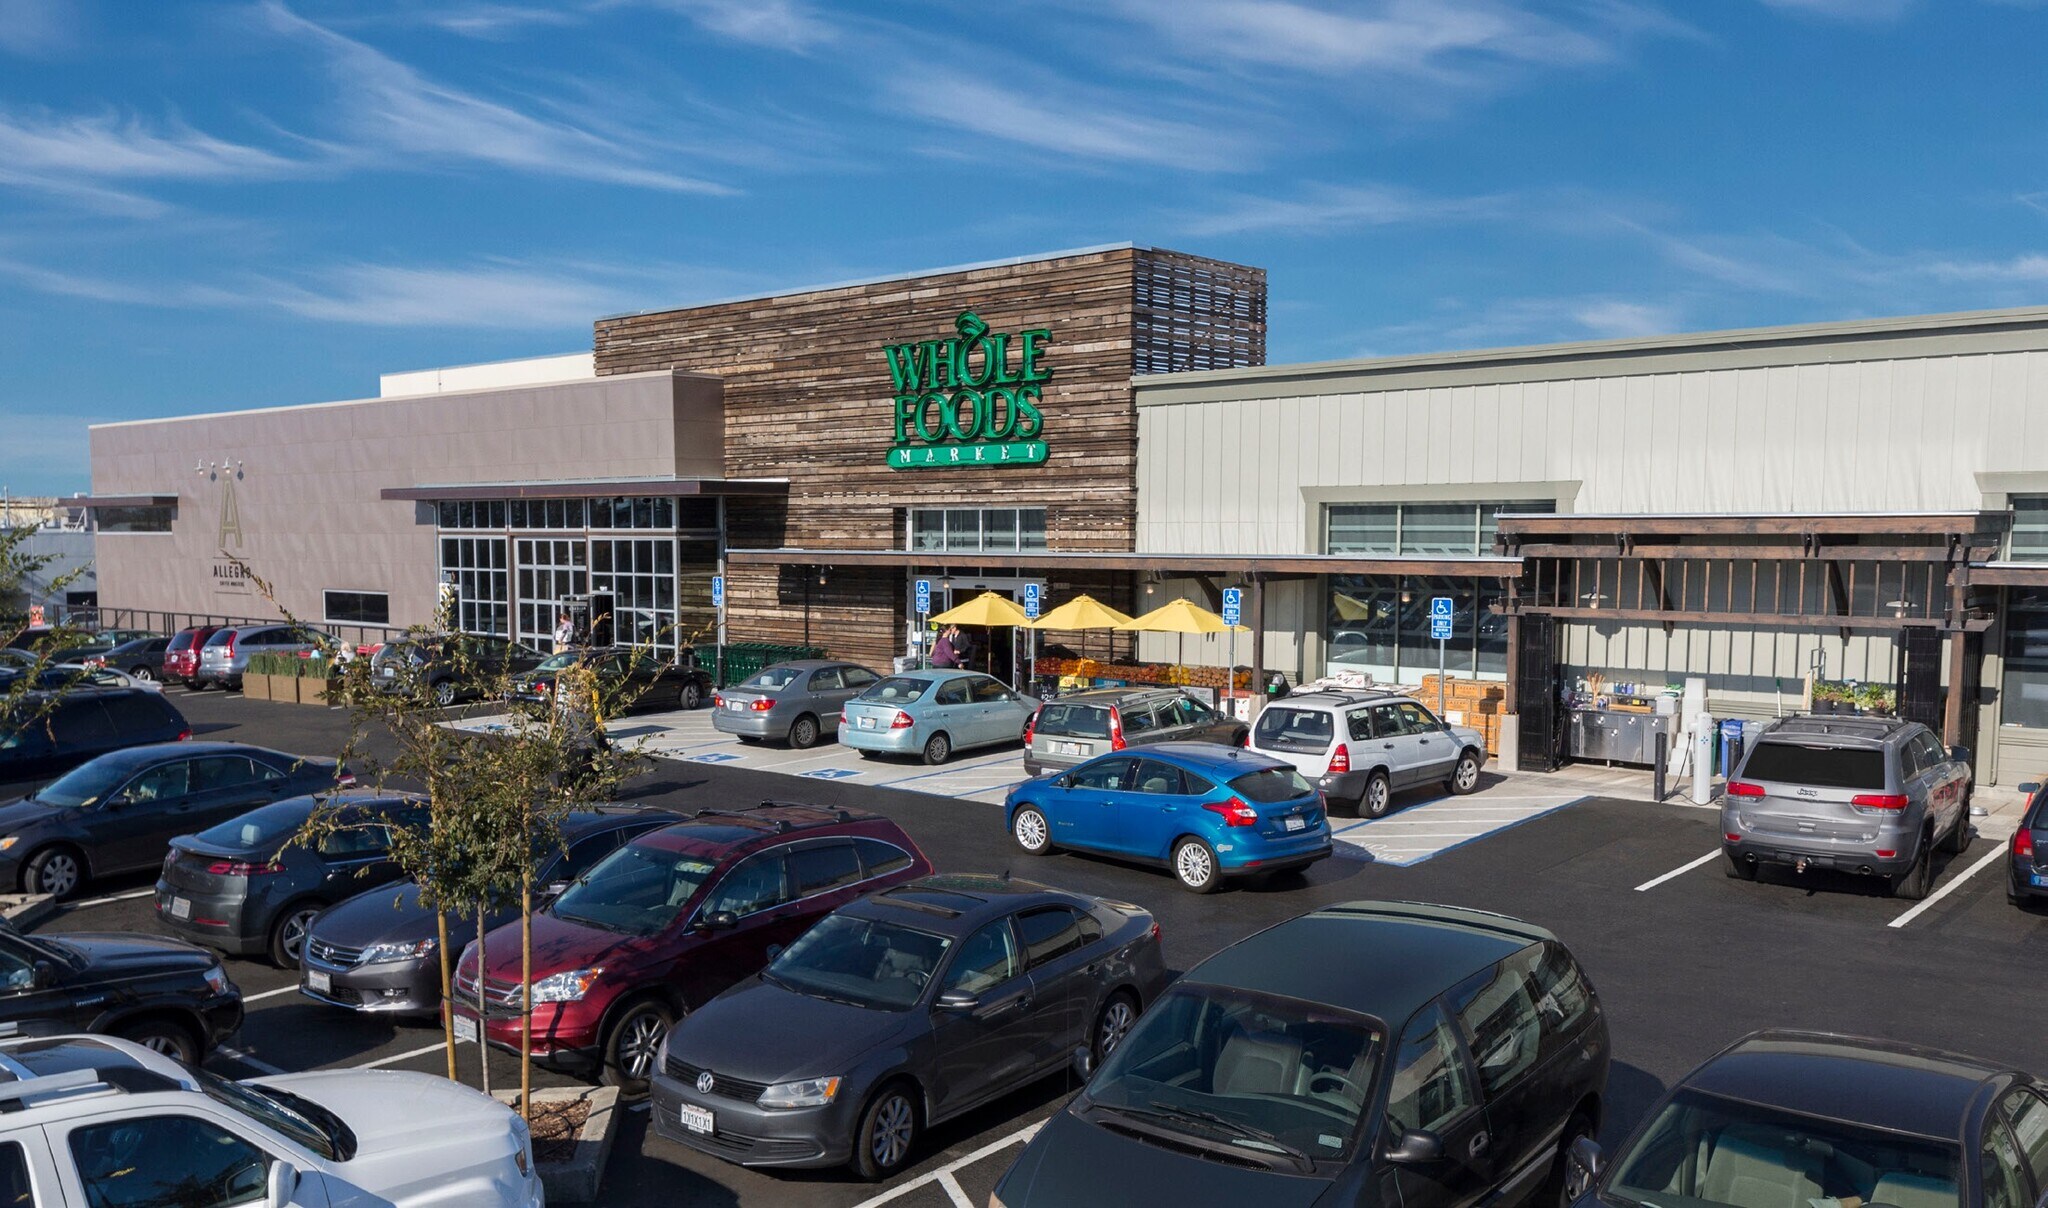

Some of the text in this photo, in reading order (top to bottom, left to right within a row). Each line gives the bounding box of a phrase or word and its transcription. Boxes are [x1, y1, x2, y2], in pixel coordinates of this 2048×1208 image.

[881, 327, 1053, 392] WHOLE
[892, 383, 1043, 443] FOODS
[900, 443, 1036, 463] MARKET
[213, 565, 251, 579] ALLEGRO
